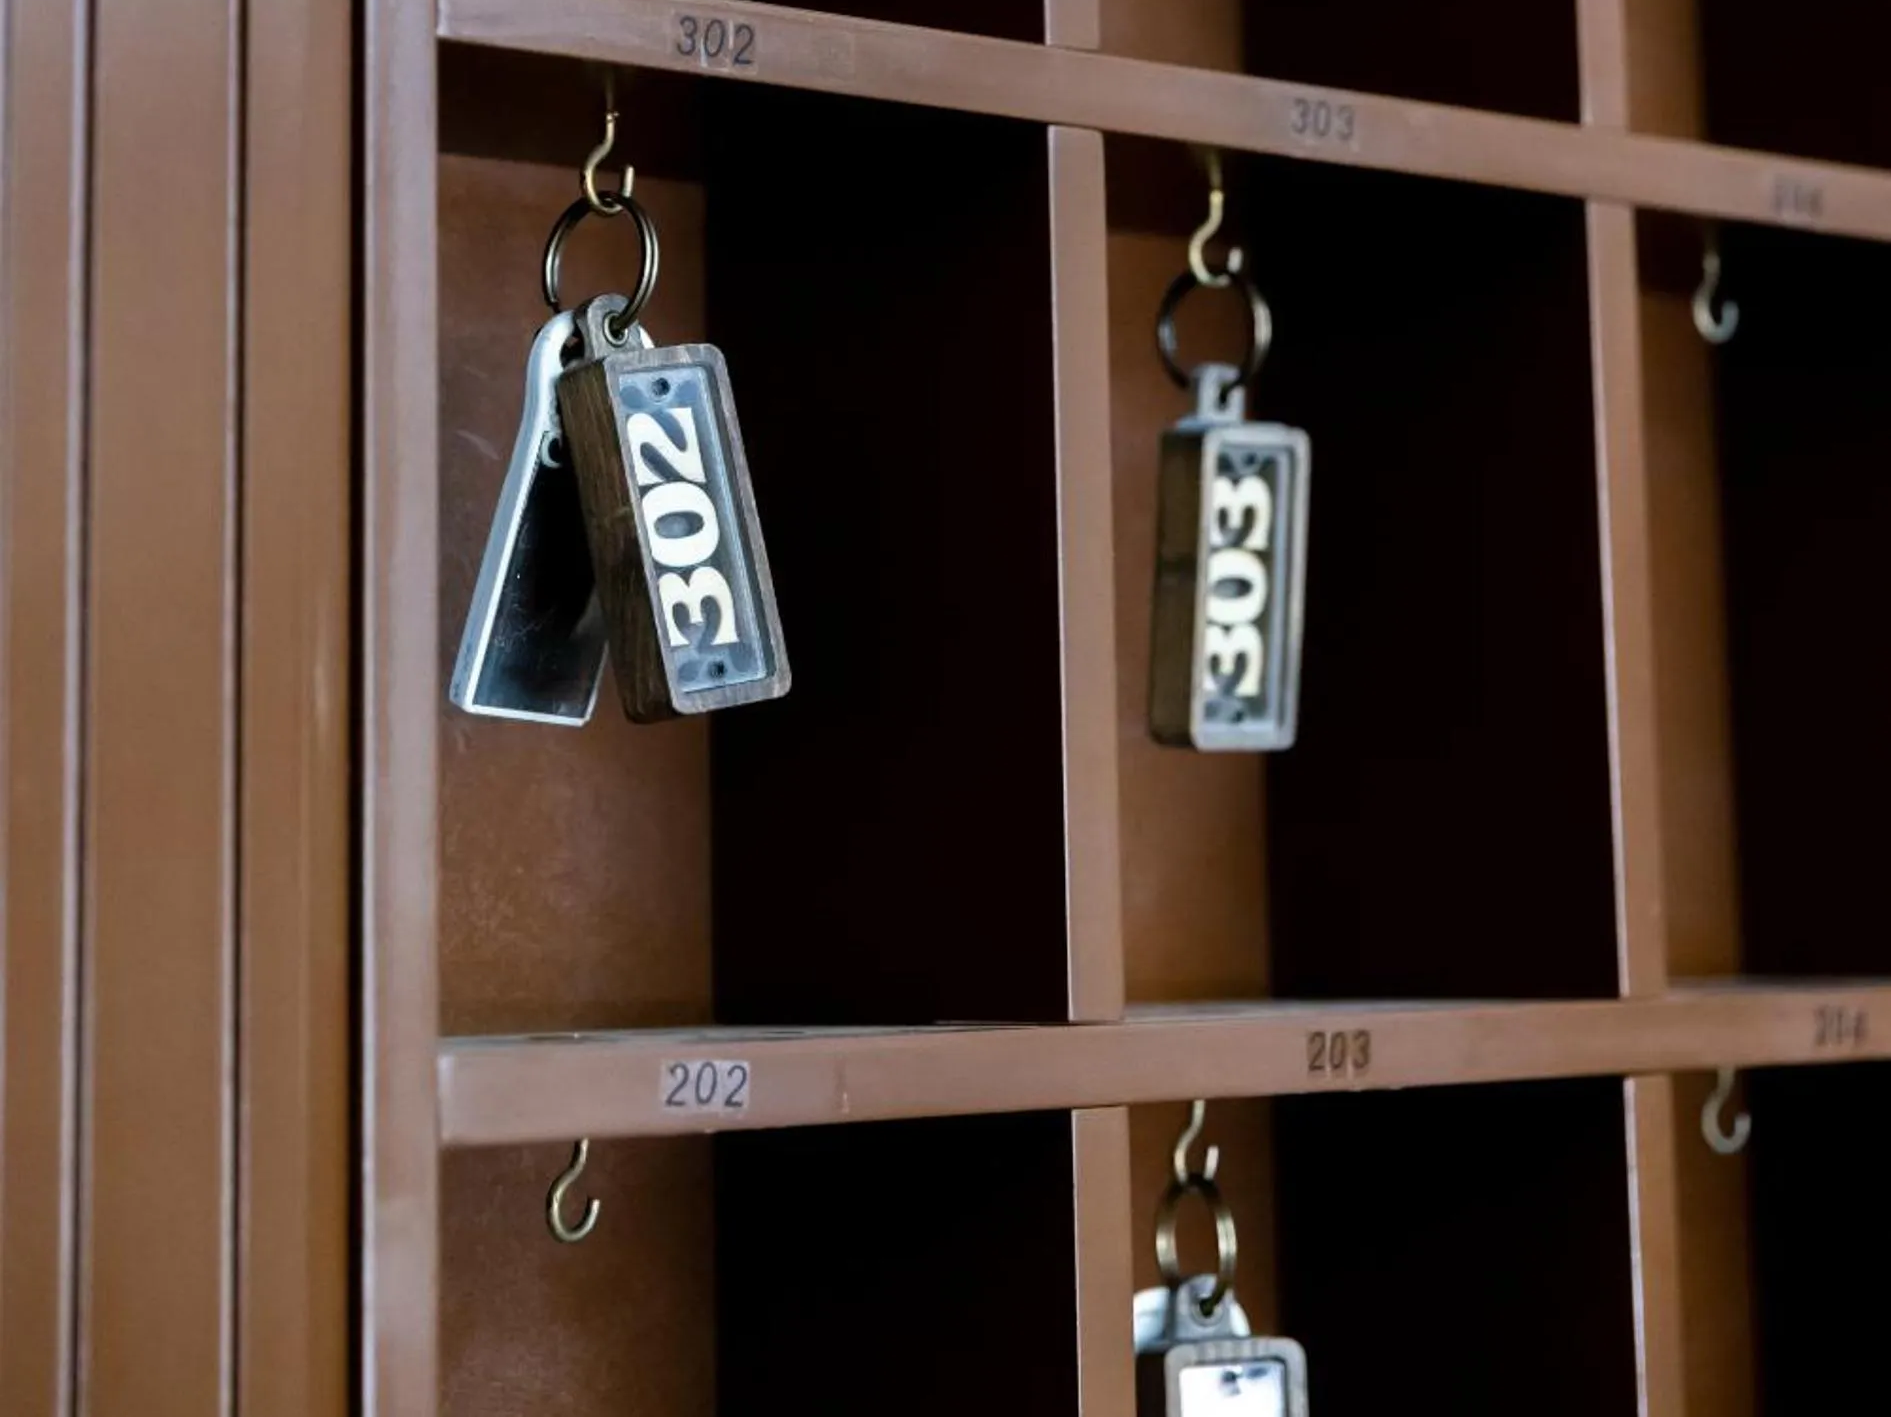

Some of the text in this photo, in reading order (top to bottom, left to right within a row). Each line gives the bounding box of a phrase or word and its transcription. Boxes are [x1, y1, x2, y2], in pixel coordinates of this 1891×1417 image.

[677, 15, 755, 65] 302
[1291, 98, 1355, 141] 303
[627, 408, 739, 646] 302
[1202, 475, 1272, 696] 303
[1308, 1029, 1370, 1072] 203
[665, 1061, 748, 1107] 202
